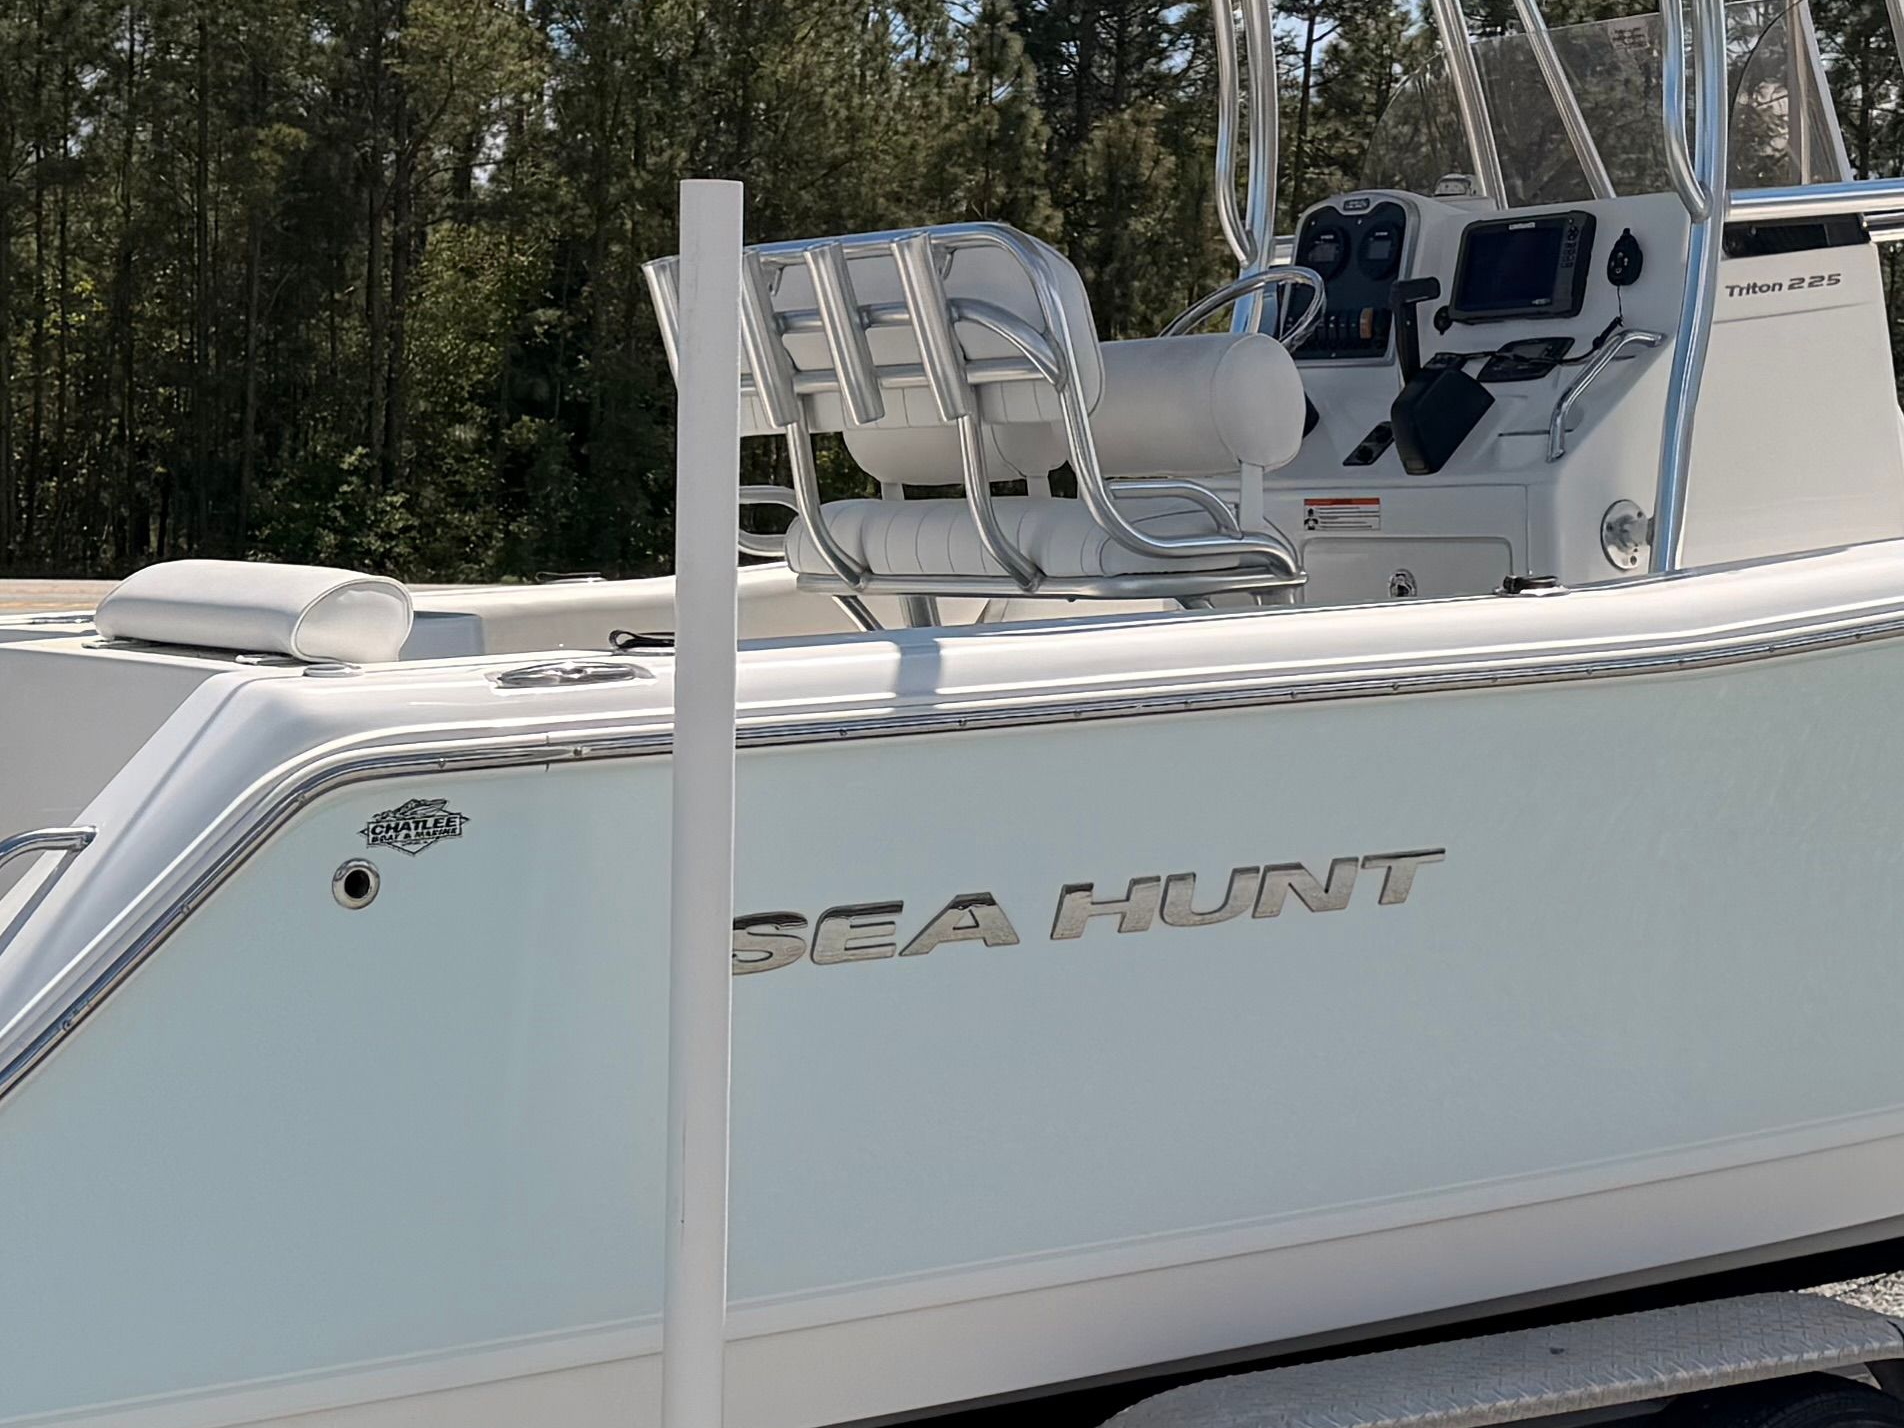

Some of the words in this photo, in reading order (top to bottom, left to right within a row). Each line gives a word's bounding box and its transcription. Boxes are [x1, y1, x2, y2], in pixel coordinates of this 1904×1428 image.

[1725, 281, 1783, 298] Triton
[1787, 272, 1842, 291] 225
[371, 816, 459, 836] CHATLEE
[371, 833, 400, 844] BOAT
[732, 890, 1021, 976] SEA
[1050, 847, 1446, 942] HUNT
